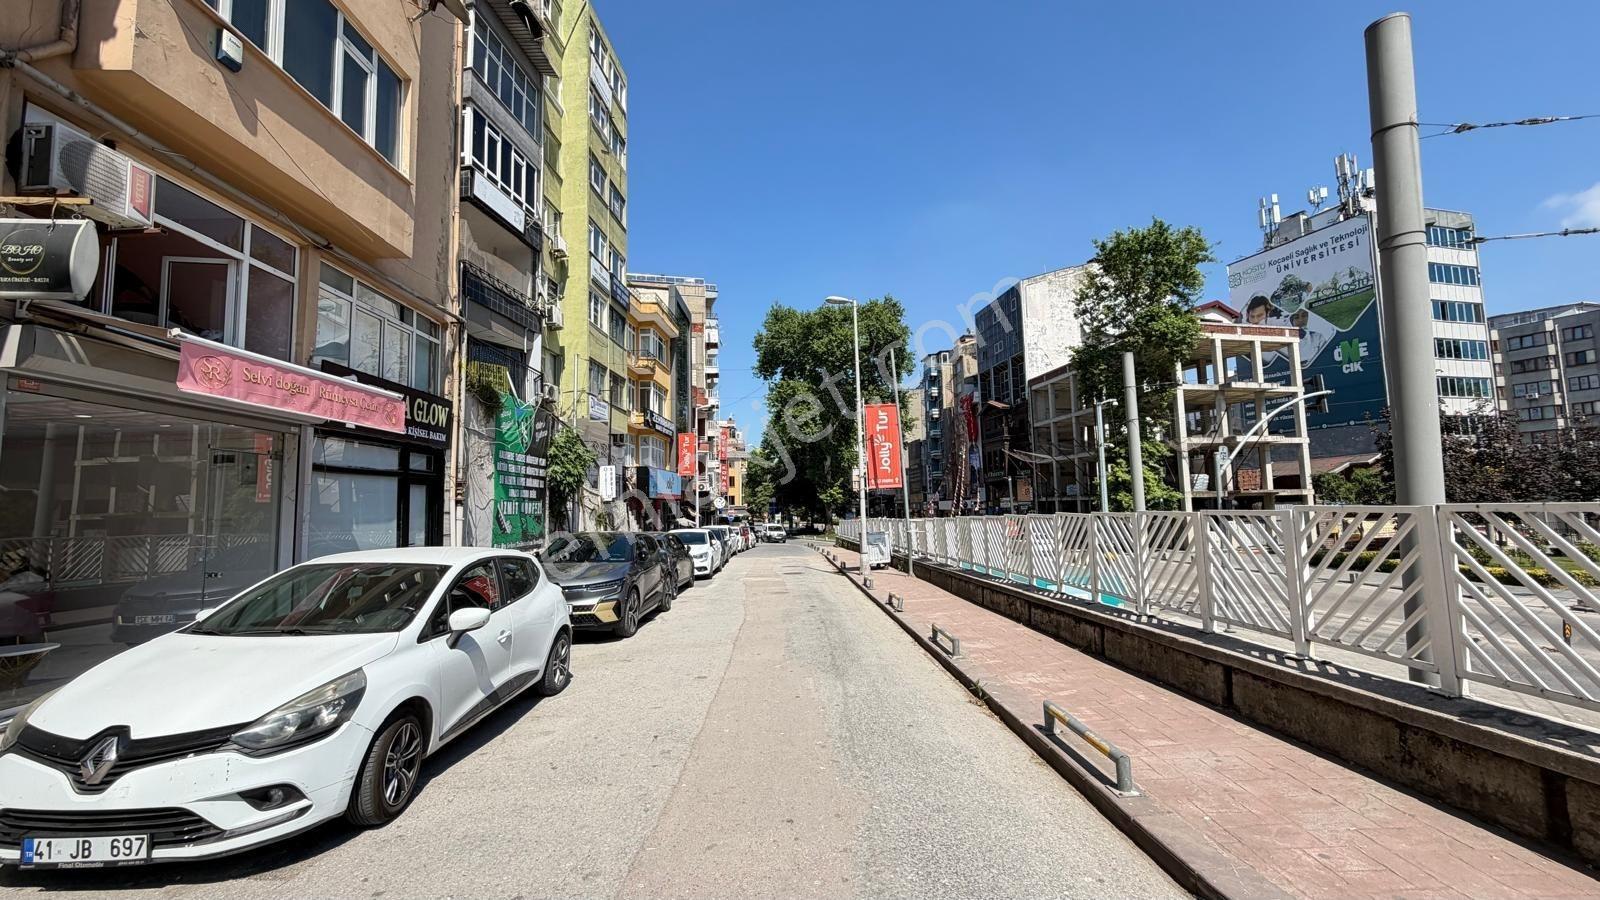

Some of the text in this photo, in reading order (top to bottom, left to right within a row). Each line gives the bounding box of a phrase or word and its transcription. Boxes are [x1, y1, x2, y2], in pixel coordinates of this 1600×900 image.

[1268, 224, 1368, 267] Kocaeli Sağlık ve Teknoloji
[1276, 234, 1361, 274] ÜNİVERSİTESİ
[243, 366, 272, 386] Selvi
[413, 397, 450, 428] GLOW
[876, 410, 889, 432] Tur
[429, 431, 447, 442] BAKIM
[683, 452, 692, 469] Jolly
[880, 442, 893, 474] Jolly
[35, 840, 52, 860] 41
[70, 840, 92, 859] JB
[110, 837, 146, 858] 697
